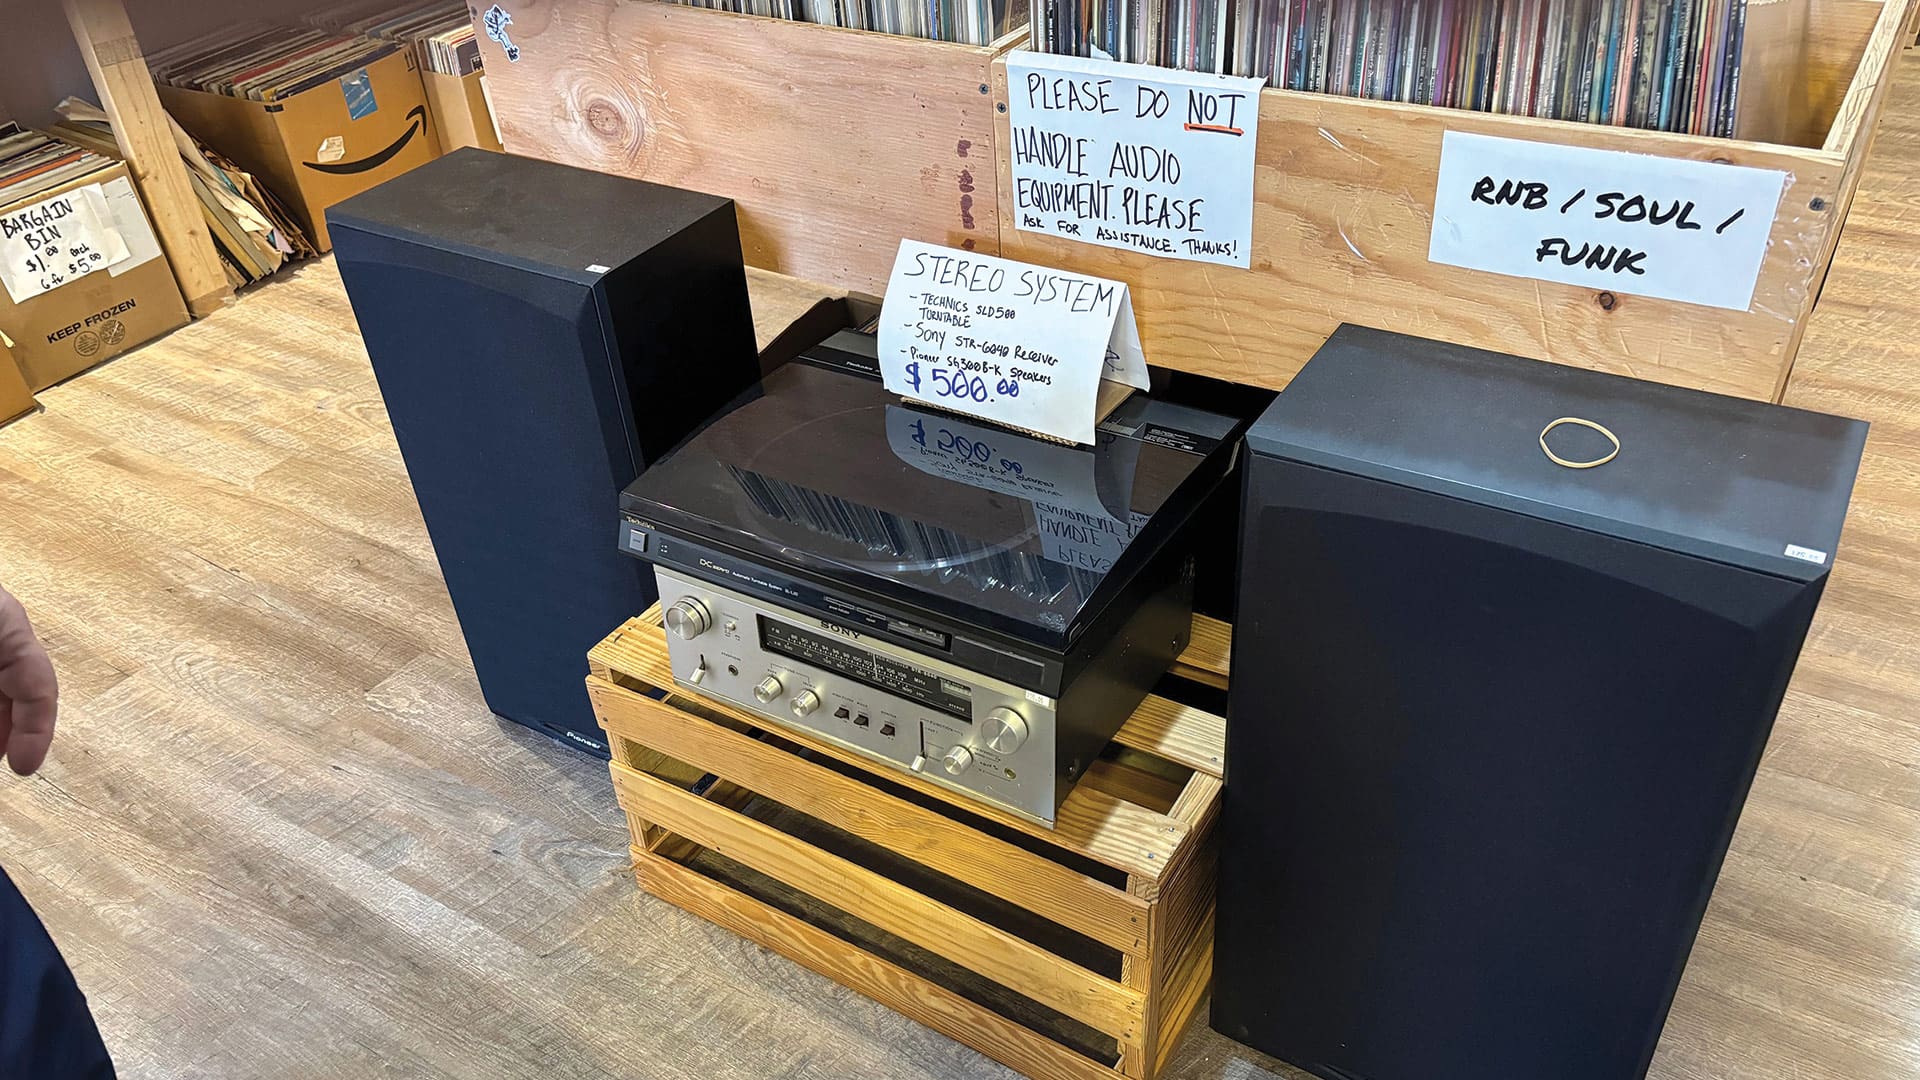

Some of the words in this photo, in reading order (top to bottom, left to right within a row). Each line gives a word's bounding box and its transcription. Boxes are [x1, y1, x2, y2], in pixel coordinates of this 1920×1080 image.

[1027, 72, 1119, 114] PLEASE
[1135, 85, 1170, 119] DO
[1187, 89, 1246, 130] NOT
[1013, 126, 1089, 177] HANDLE
[1108, 142, 1181, 185] AUDIO
[0, 198, 73, 239] BARGAIN
[1017, 177, 1116, 221] EQUIPMENT.
[1122, 186, 1205, 233] PLEASE
[1470, 175, 1549, 210] RNB
[1594, 192, 1701, 231] SOUL
[24, 224, 62, 251] BIN
[1023, 213, 1045, 229] ASK
[1057, 220, 1081, 237] FOR
[1096, 226, 1177, 254] ASSISTANCE.
[1182, 238, 1239, 260] THANKS!
[1536, 238, 1648, 276] FUNK
[904, 252, 1005, 293] STEREO
[1013, 270, 1115, 318] SYSTEM
[920, 292, 969, 313] TECHNICS
[47, 322, 82, 344] KEEP
[85, 298, 137, 328] FROZEN
[918, 307, 972, 329] TURNTABLE
[914, 321, 946, 351] Sony
[1014, 345, 1059, 366] Receiver
[820, 620, 860, 640] SONY
[566, 731, 601, 749] Pioneer
